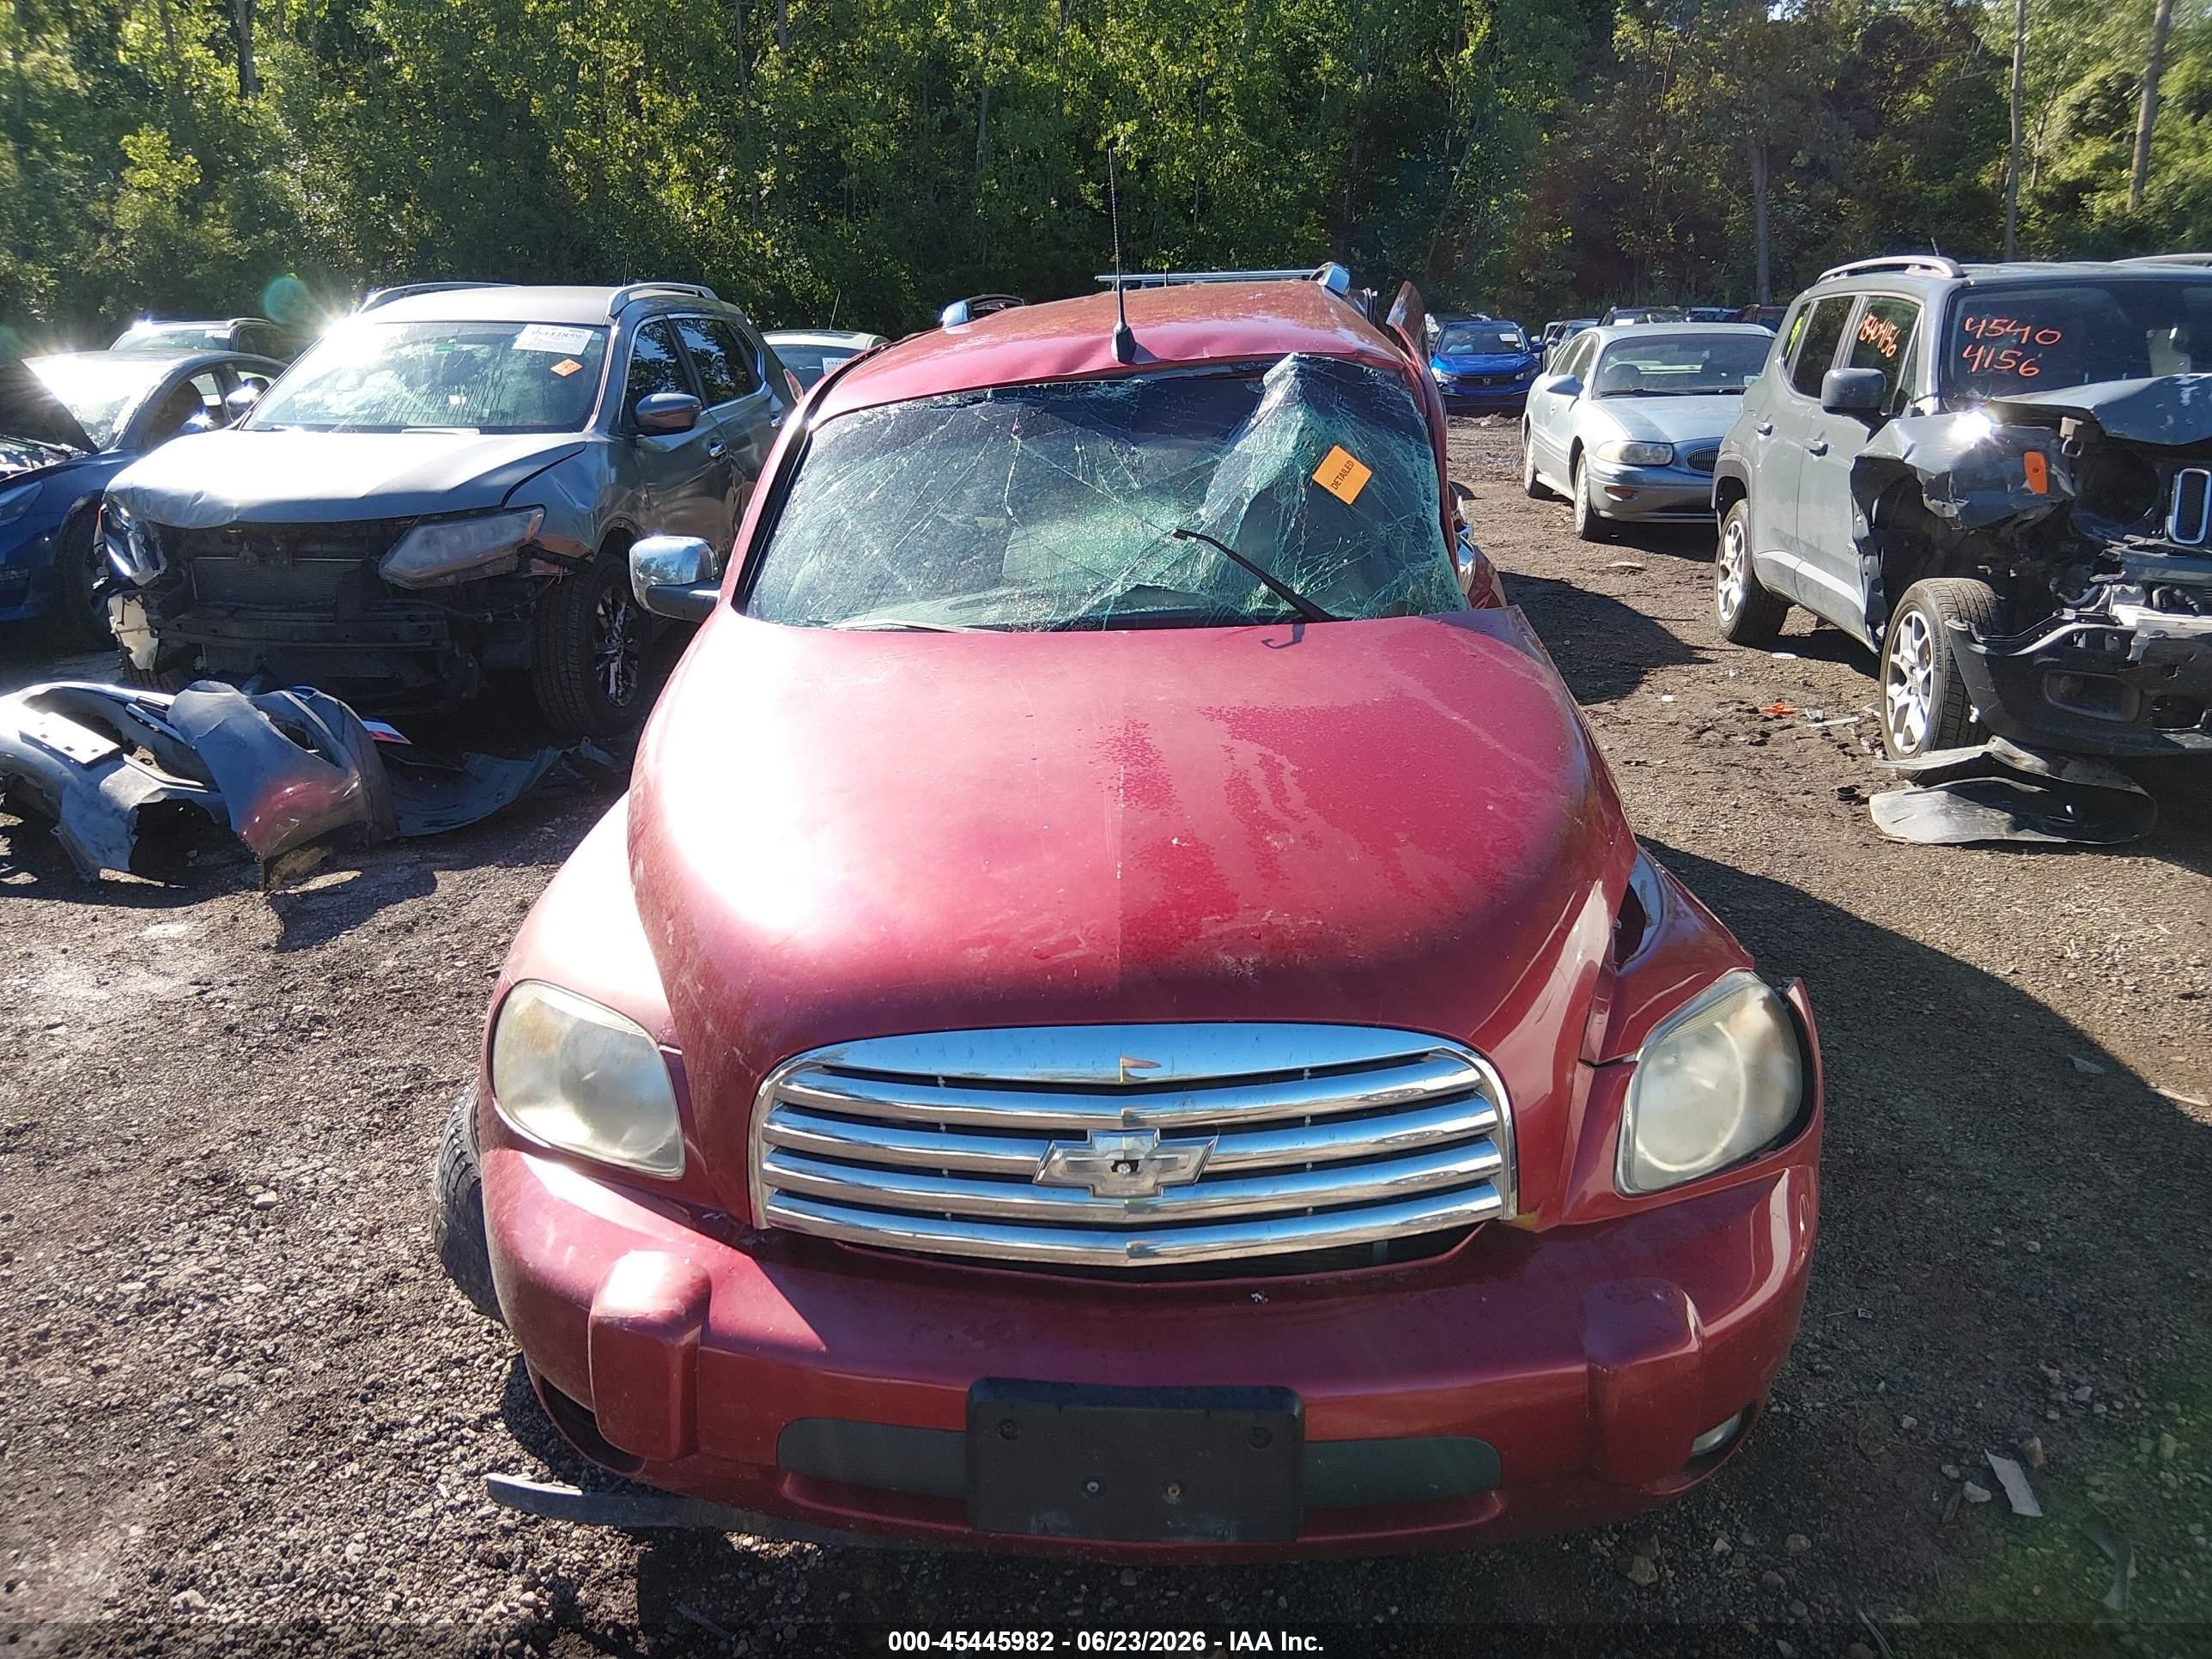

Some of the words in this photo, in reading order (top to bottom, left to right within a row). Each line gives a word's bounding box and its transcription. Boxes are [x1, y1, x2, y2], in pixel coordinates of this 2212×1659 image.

[1964, 315, 2062, 345] 4540
[1962, 344, 2040, 377] 4156
[1330, 460, 1354, 490] DETAILED
